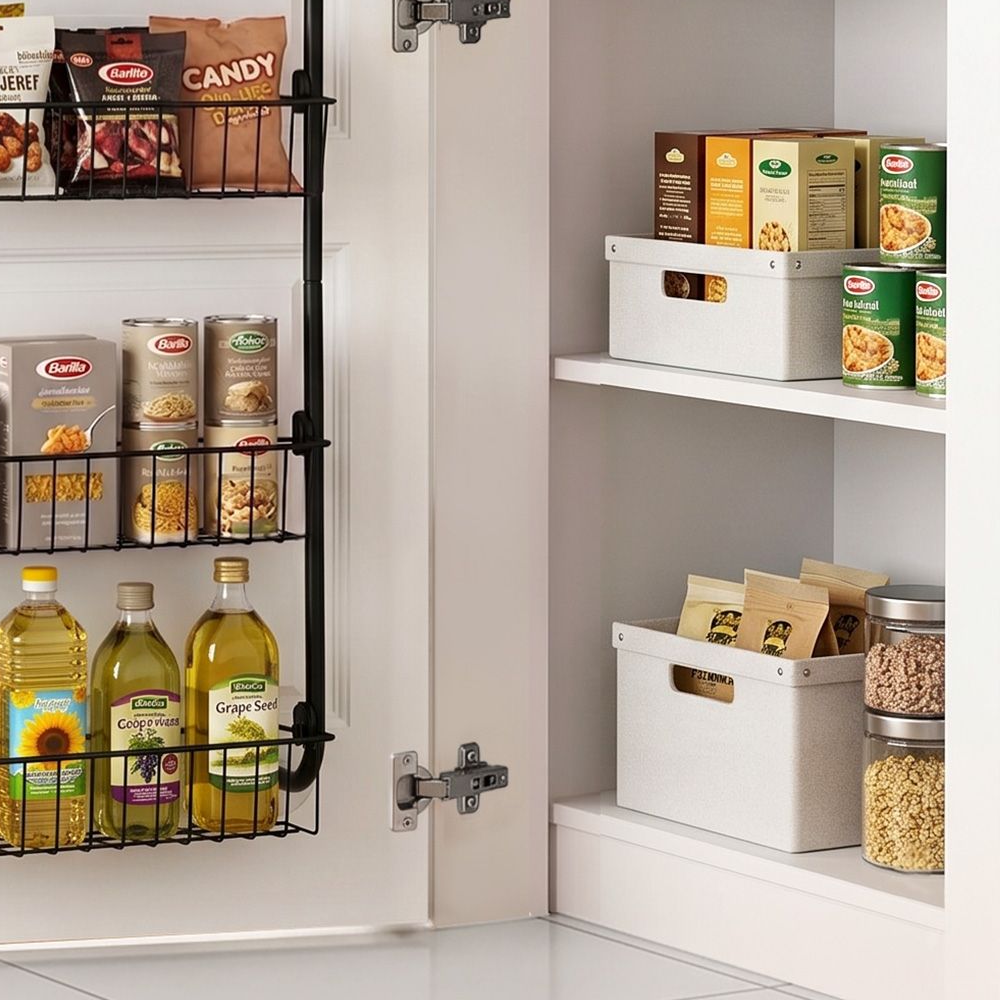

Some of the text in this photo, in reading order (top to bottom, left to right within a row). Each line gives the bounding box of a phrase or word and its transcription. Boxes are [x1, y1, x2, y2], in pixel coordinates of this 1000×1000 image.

[182, 51, 275, 92] CANDY
[0, 74, 40, 92] JEREF
[215, 697, 278, 717] Grape Seed
